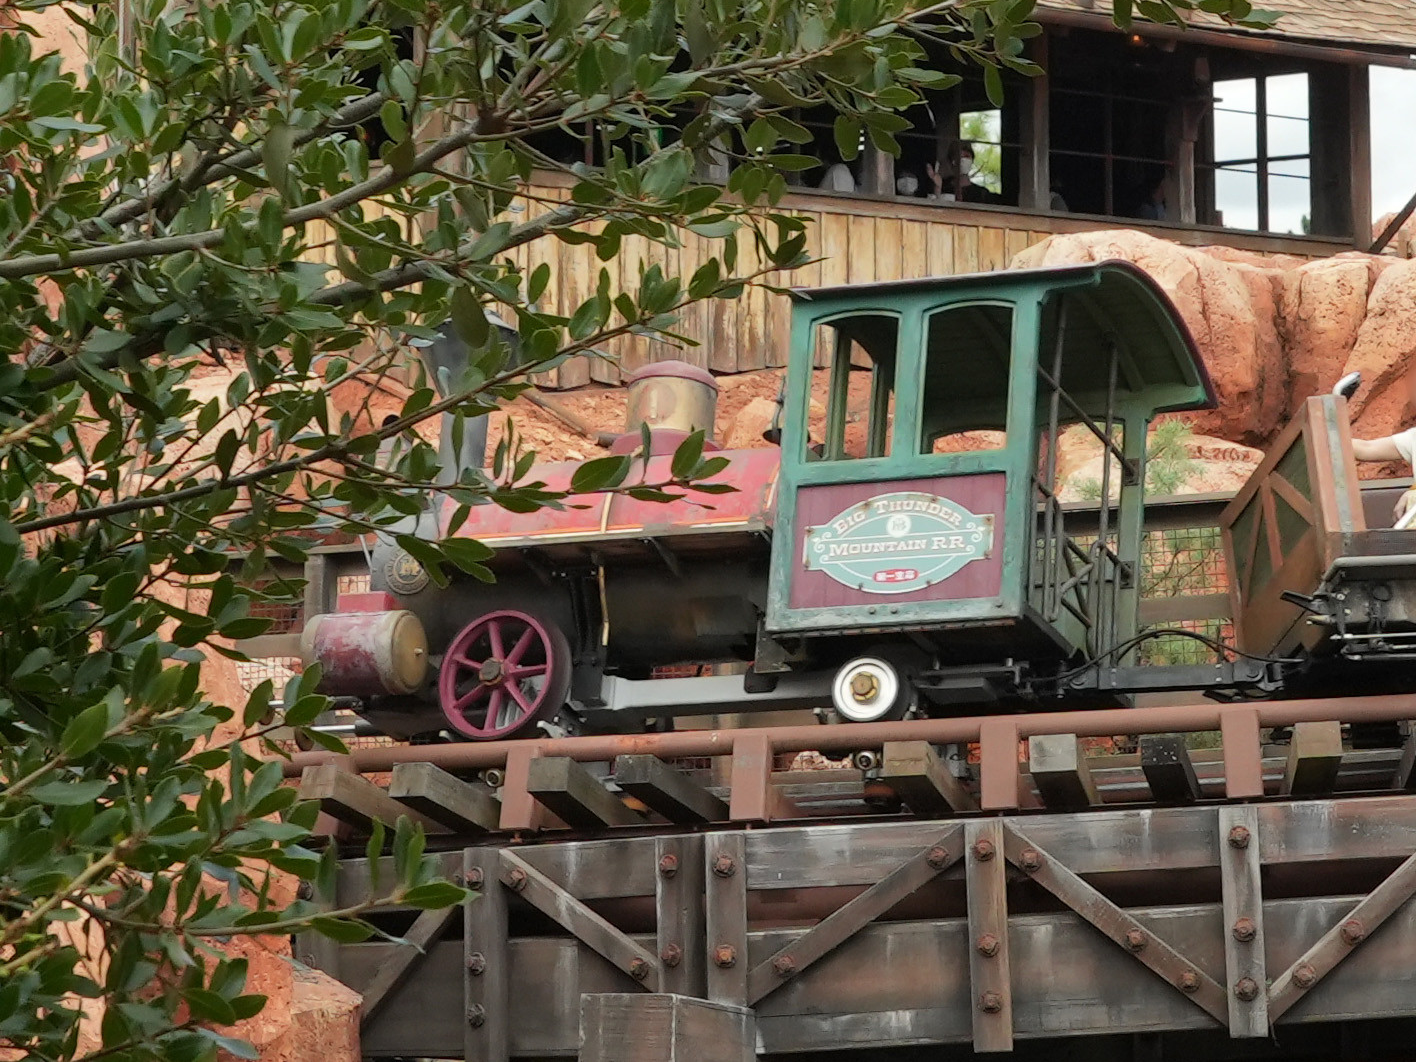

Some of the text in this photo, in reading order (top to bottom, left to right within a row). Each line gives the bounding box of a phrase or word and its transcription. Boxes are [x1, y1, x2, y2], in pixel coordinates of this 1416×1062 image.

[834, 512, 865, 534] BIG
[874, 501, 962, 525] THUNDER
[829, 536, 966, 556] MOUNTAIN RR
